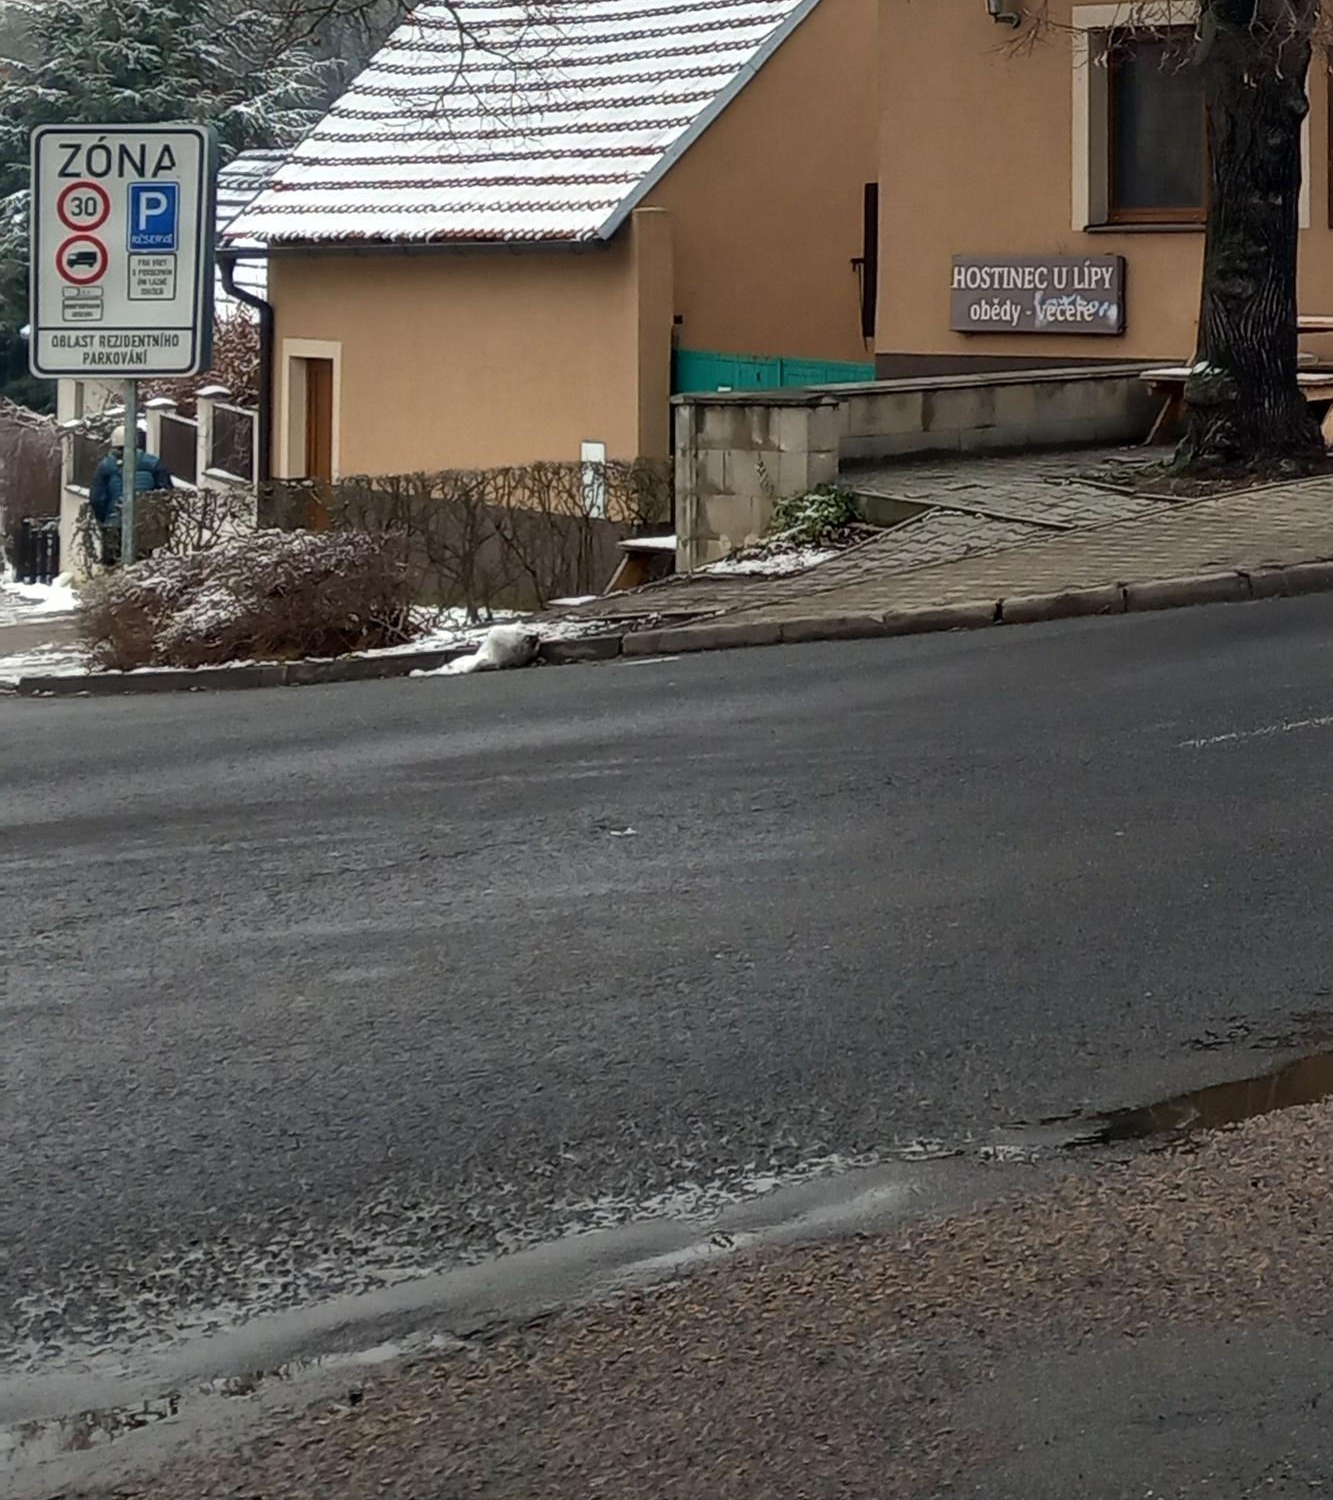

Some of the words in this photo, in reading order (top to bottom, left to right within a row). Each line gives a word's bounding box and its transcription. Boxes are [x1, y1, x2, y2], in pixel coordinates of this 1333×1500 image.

[58, 136, 178, 179] ZÓNA
[70, 196, 97, 217] 30
[139, 191, 168, 231] P
[951, 266, 1048, 289] HOSTINEC
[1054, 267, 1067, 288] U
[1073, 260, 1113, 289] LÍPY
[970, 298, 1021, 326] obědy
[51, 334, 95, 348] OBLAST
[99, 332, 179, 348] REZIDENTNÍHO
[83, 348, 147, 365] PARKOVÁNÍ
